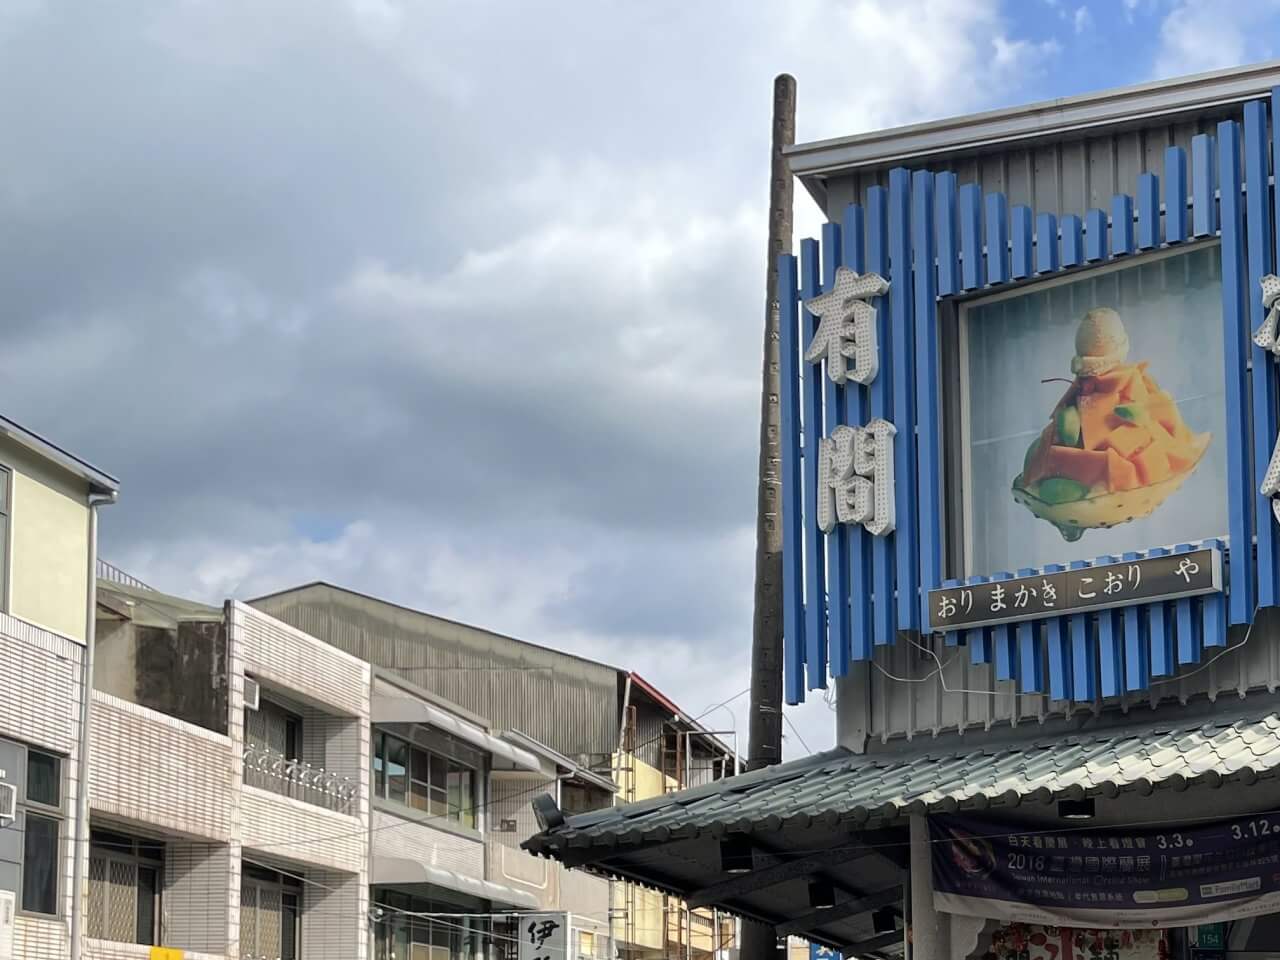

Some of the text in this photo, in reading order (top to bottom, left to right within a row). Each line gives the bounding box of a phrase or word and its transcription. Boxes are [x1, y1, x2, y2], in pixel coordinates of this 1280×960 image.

[804, 265, 898, 536] 有間
[938, 558, 1200, 619] おり まかき こおり や
[1156, 819, 1272, 850] 3.3 3.12
[1008, 853, 1045, 871] 2018
